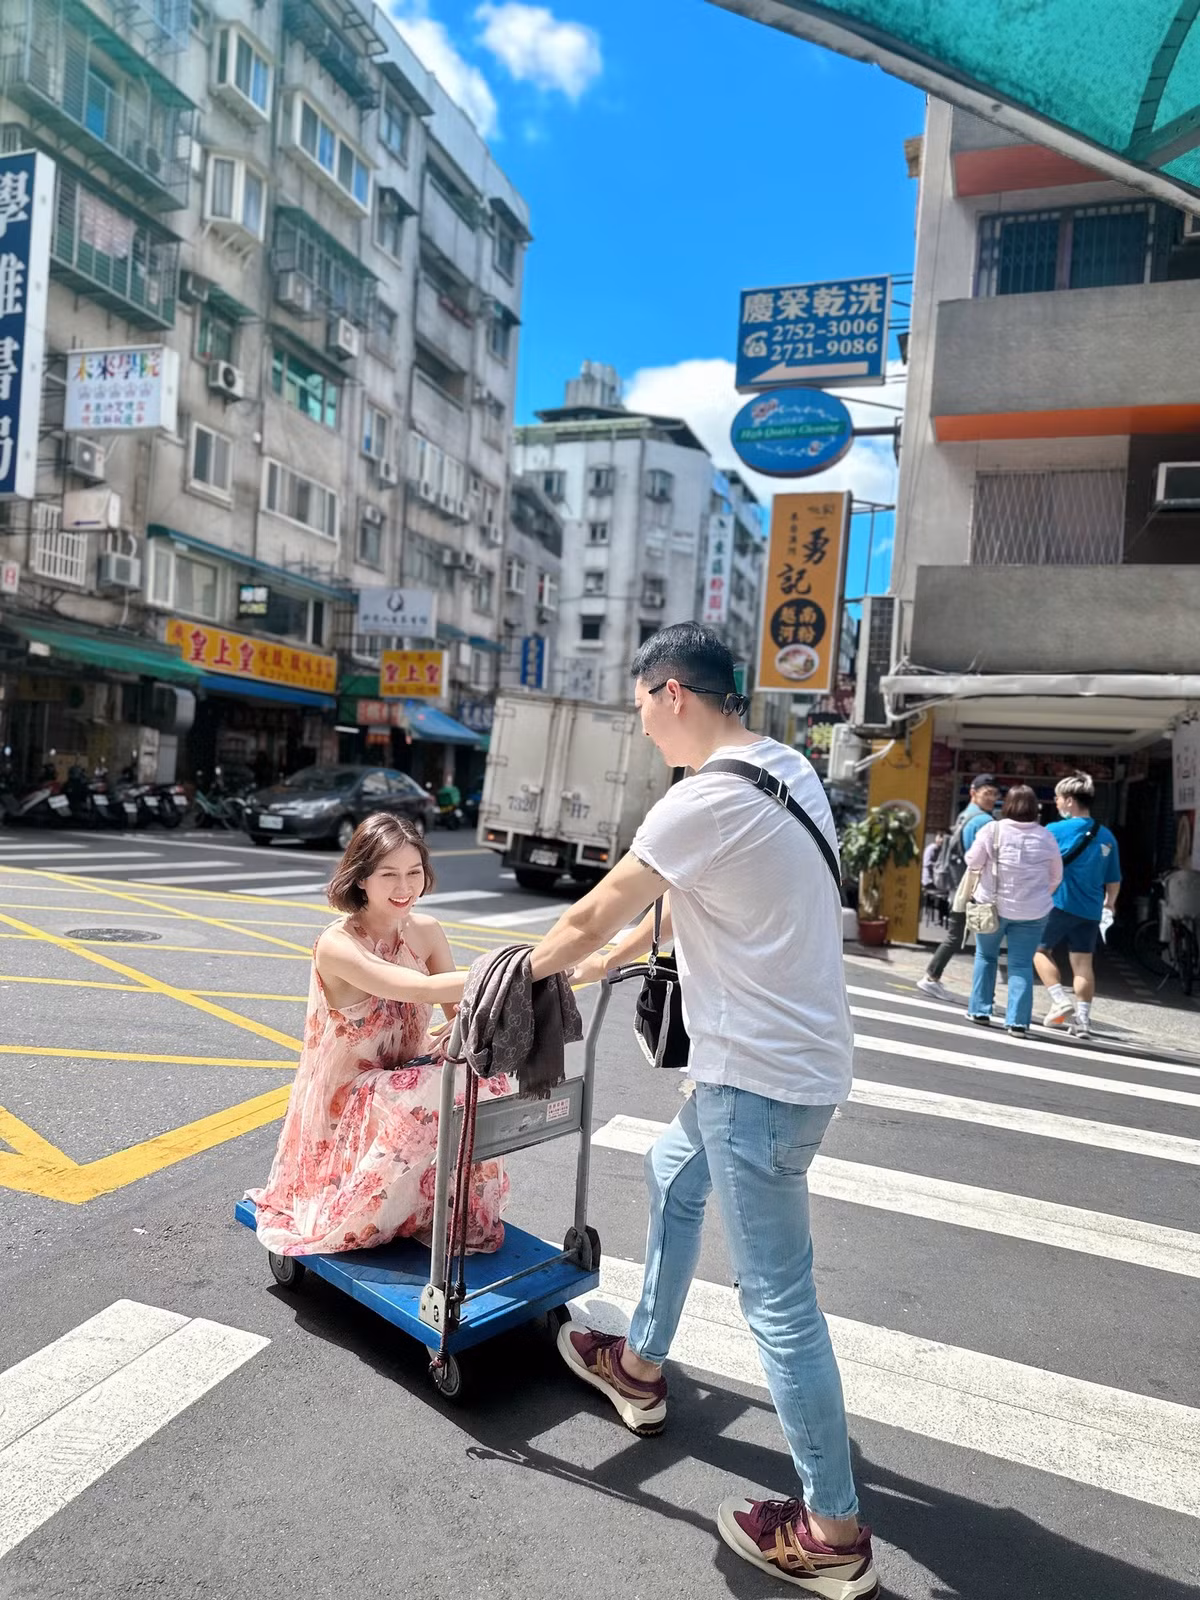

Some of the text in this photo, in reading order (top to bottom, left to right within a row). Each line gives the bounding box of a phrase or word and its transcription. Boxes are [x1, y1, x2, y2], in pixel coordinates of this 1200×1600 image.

[743, 283, 882, 323] 慶榮乾洗
[772, 319, 879, 342] 2752-3006
[771, 339, 879, 361] 2721-9086
[73, 352, 160, 382] 未來學院
[764, 425, 797, 439] Quality
[777, 526, 831, 596] 勇記
[189, 628, 256, 673] 皇上皇
[384, 662, 441, 684] 皇上皇
